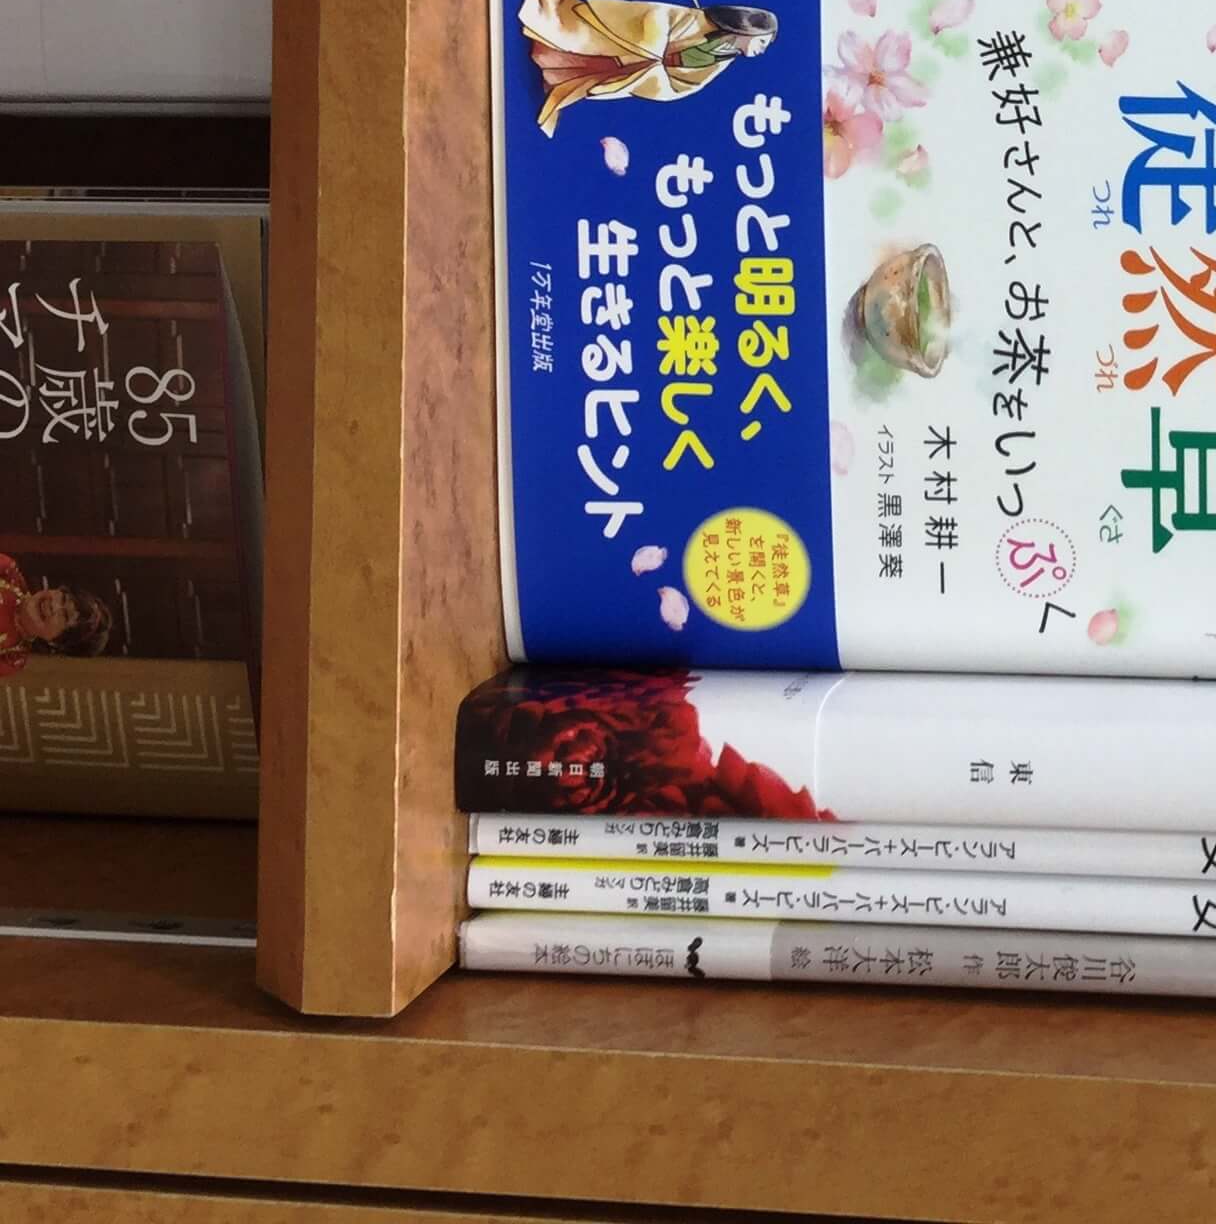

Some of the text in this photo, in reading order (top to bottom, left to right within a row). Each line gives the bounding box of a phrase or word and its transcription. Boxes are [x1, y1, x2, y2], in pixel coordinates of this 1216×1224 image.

[1091, 179, 1116, 230] つれ
[733, 93, 796, 442] もっと明るく、
[527, 260, 555, 374] 1万年堂出版
[654, 154, 717, 470] もっと楽しく
[976, 29, 1077, 634] 兼好さんと、お茶をいっぷく
[575, 218, 644, 539] 生きるヒント
[1093, 344, 1120, 394] づれ
[876, 423, 903, 580] イラスト 黒澤葵
[923, 424, 959, 594] 木村耕一
[1096, 502, 1124, 546] ぐさ
[701, 529, 724, 611] 見えてくる
[723, 516, 747, 624] 新しい景色が
[746, 534, 768, 605] を開くと、
[769, 529, 792, 611] 『徒然草』
[483, 759, 605, 779] 朝日新聞出版
[968, 759, 1034, 786] 東信
[499, 826, 579, 846] 主婦の友社
[489, 880, 570, 900] 主婦の友社
[790, 944, 934, 977] 松本大洋 絵
[963, 951, 1137, 984] 谷川俊太郎 作
